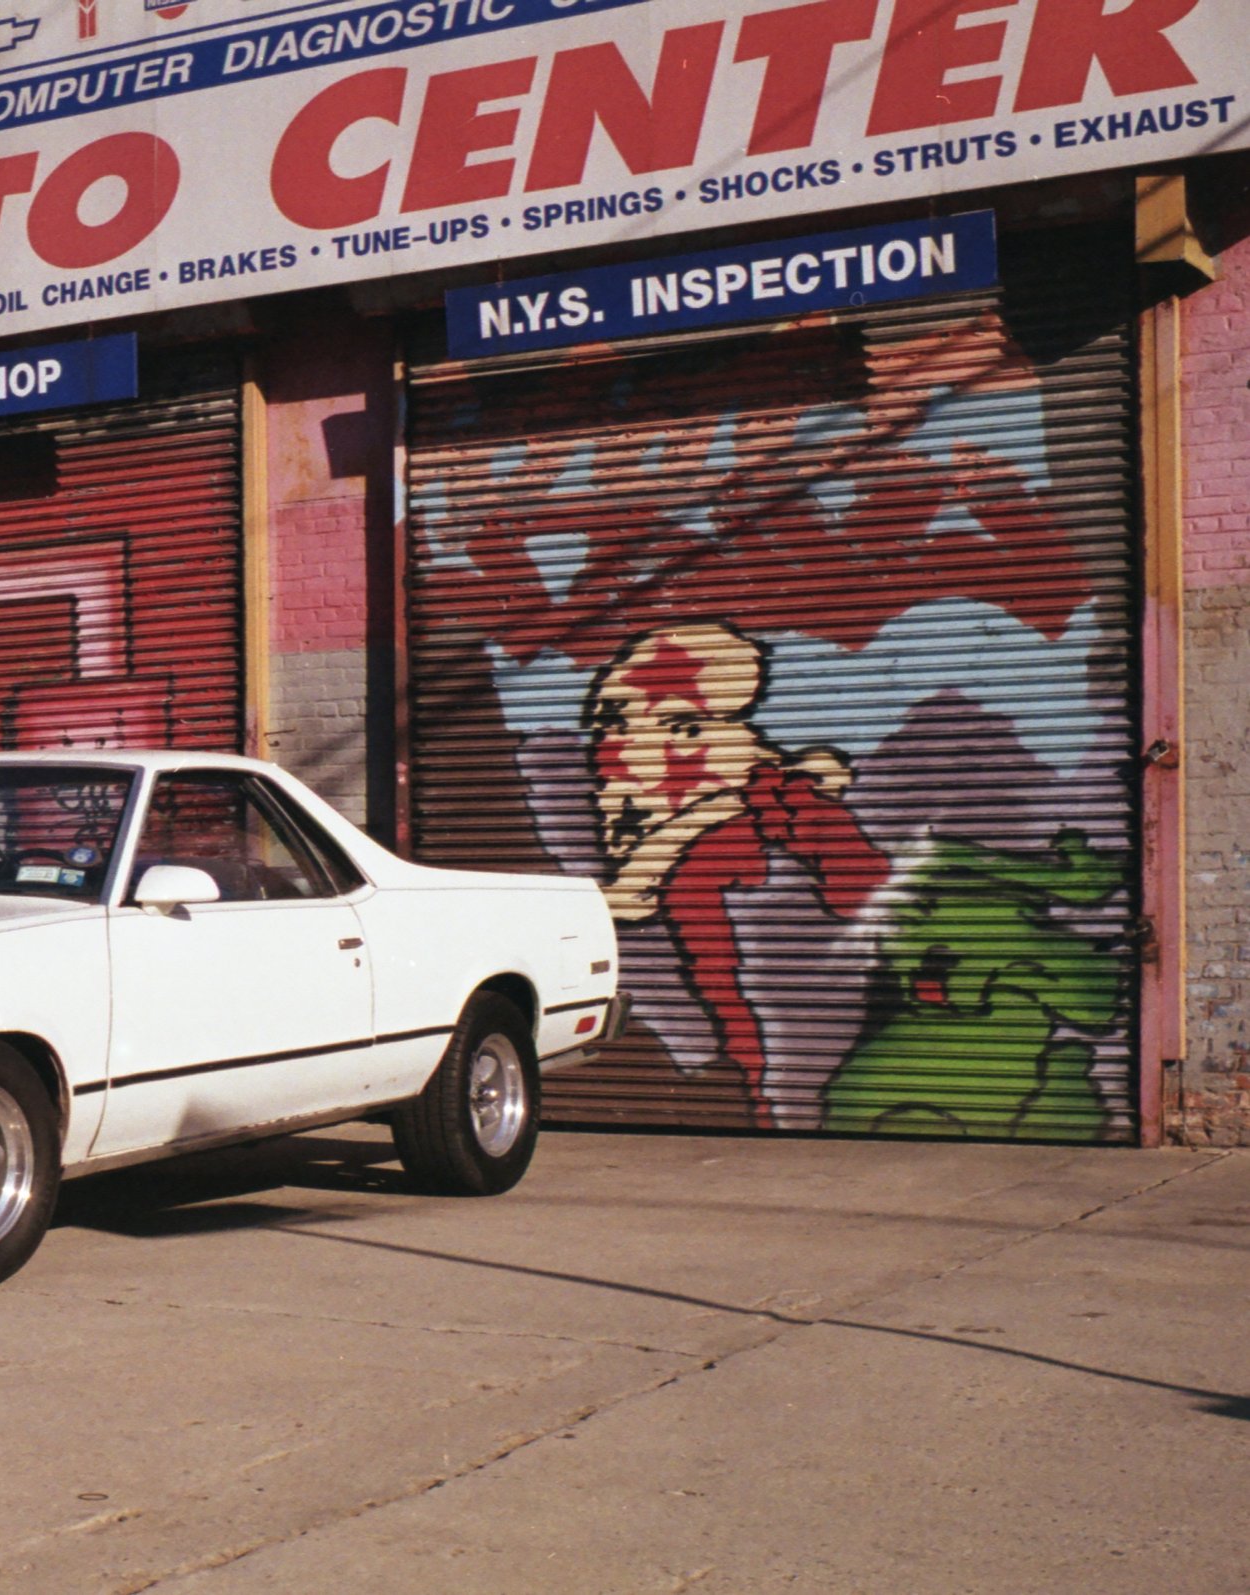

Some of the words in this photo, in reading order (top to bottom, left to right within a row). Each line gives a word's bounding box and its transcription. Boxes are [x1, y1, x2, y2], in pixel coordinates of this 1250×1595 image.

[222, 0, 516, 76] DIAGNOSTIC
[270, 0, 1199, 231] CENTER
[42, 268, 151, 308] CHANGE
[178, 244, 298, 285] BRAKES
[332, 213, 490, 259] TUNE-UPS
[523, 186, 664, 231] SPRINGS
[699, 158, 841, 204] SHOCKS
[873, 130, 1017, 177] STRUTS
[1054, 95, 1236, 149] EXHAUST
[479, 286, 604, 339] N.Y.S.
[631, 233, 956, 317] INSPECTION
